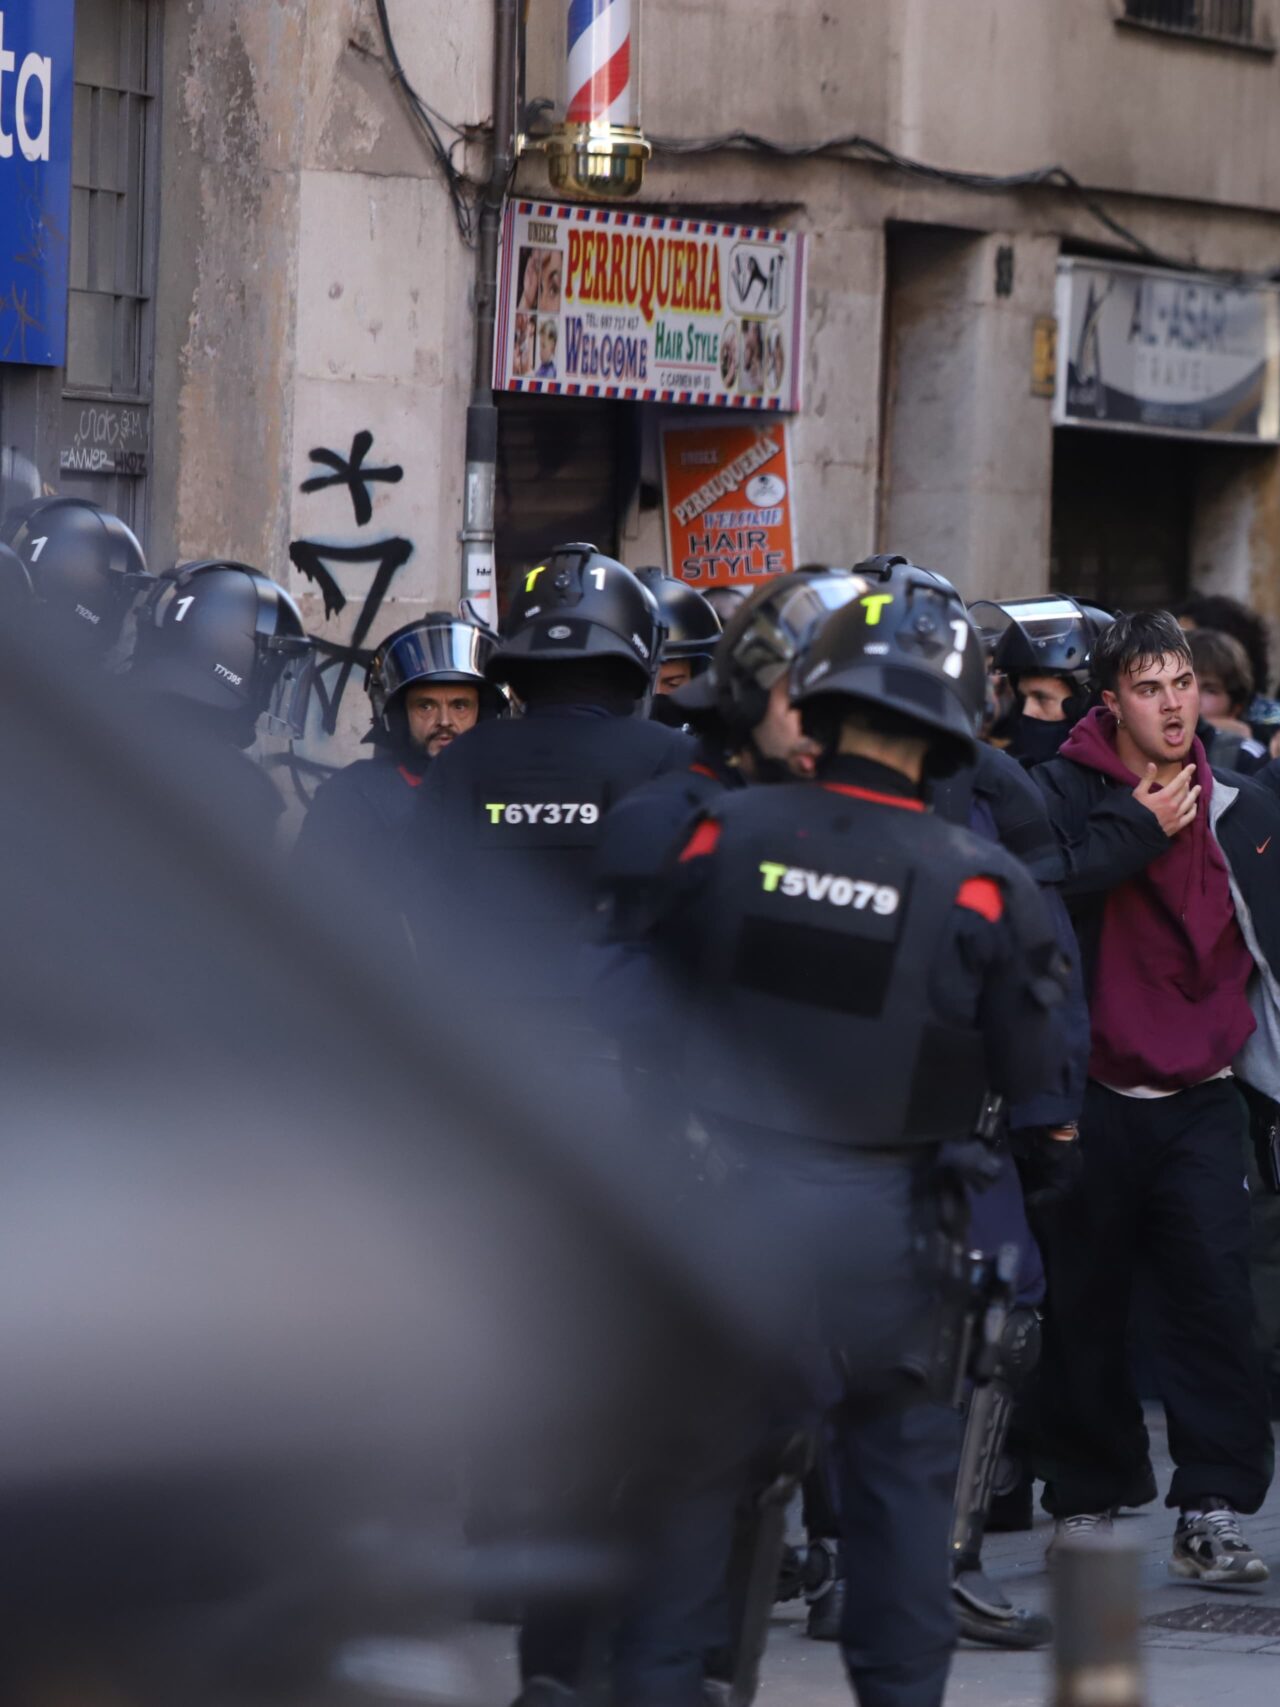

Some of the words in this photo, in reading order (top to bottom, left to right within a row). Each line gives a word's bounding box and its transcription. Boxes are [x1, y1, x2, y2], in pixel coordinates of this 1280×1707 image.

[528, 221, 558, 243] UNISEX
[565, 229, 722, 322] PERRUQUERIA
[673, 437, 780, 527] PERRUQUERIA
[30, 536, 48, 562] 1
[688, 530, 767, 554] HAIR
[682, 552, 785, 579] STYLE
[525, 566, 546, 592] T
[590, 567, 606, 591] 1
[175, 596, 195, 622] 1
[860, 594, 894, 625] T
[486, 803, 599, 824] T6Y379
[760, 861, 899, 915] T5V079
